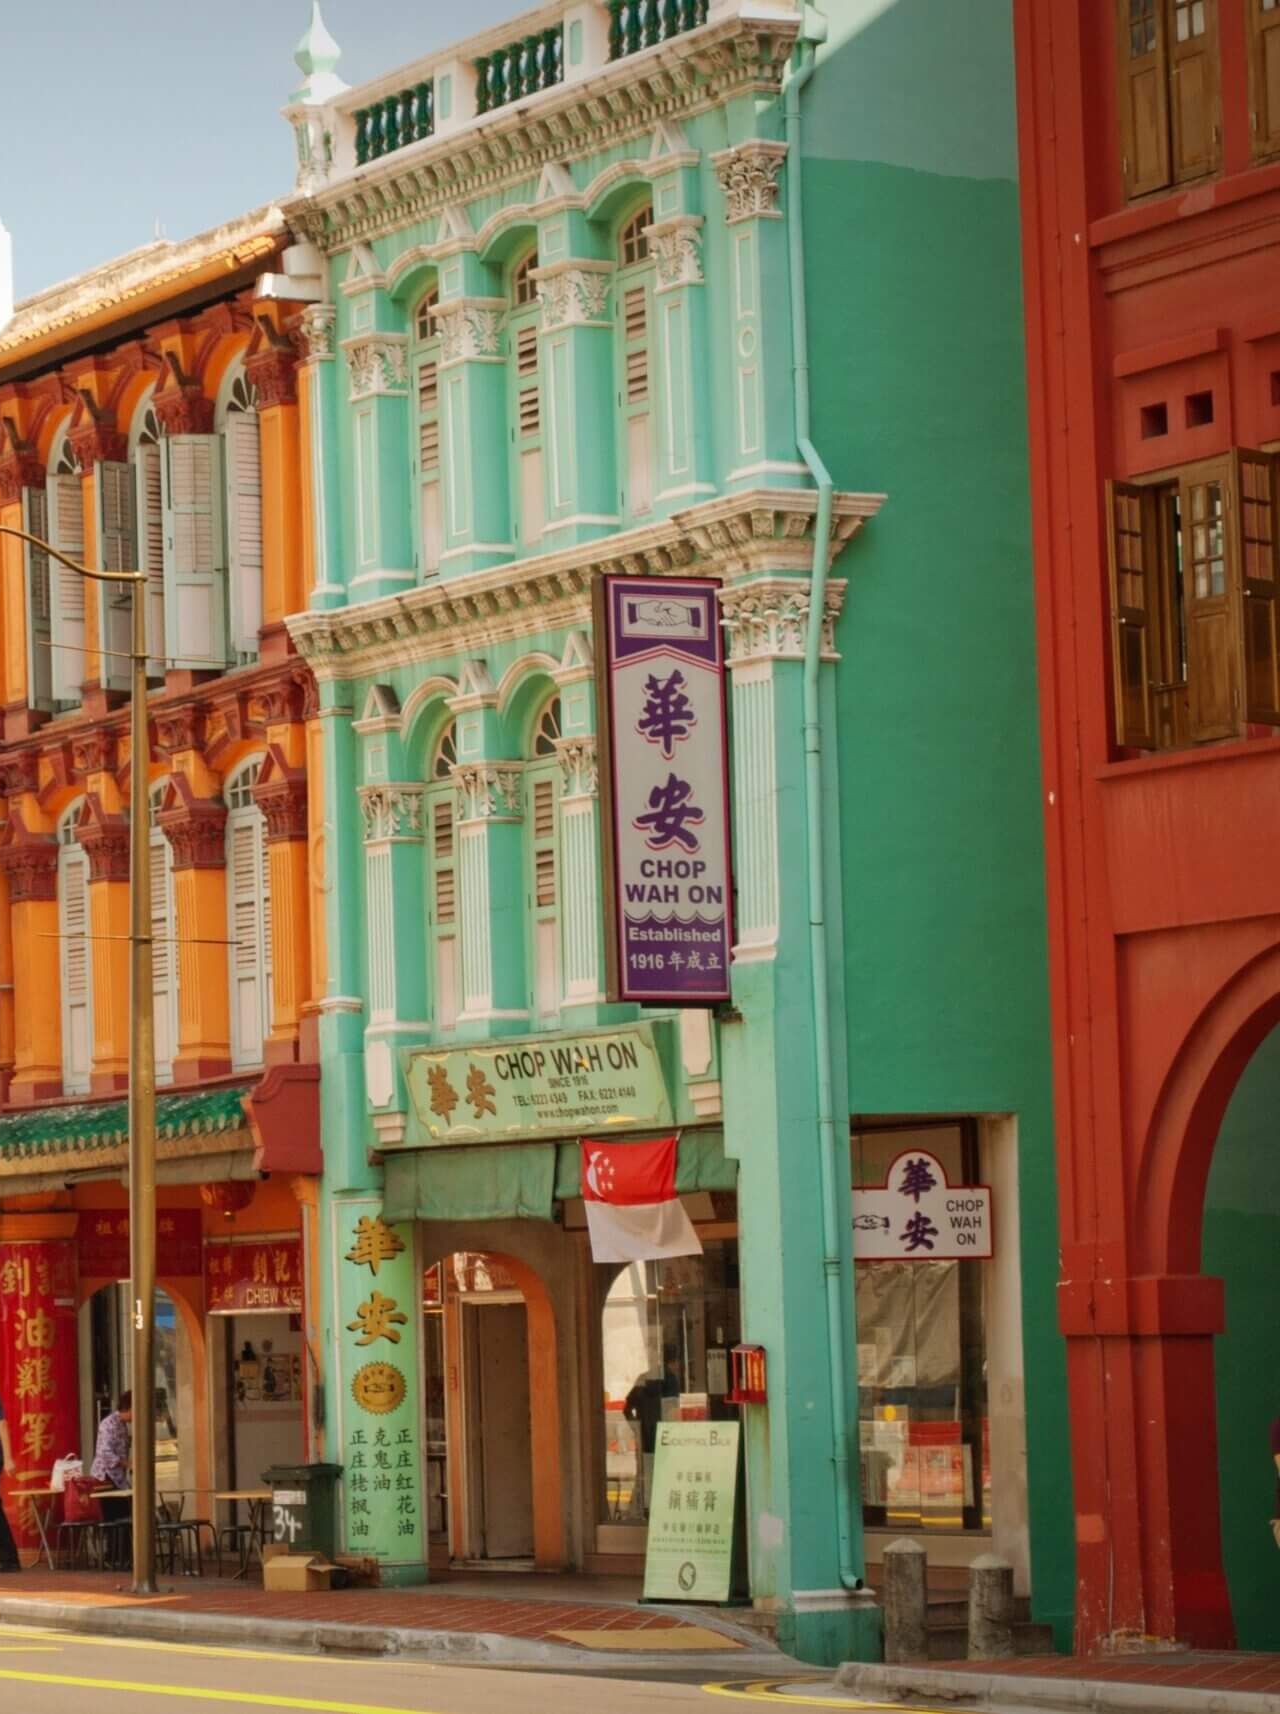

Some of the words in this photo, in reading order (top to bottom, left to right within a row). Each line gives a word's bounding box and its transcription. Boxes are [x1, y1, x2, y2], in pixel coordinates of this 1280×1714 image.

[634, 669, 705, 852] 華安
[640, 859, 706, 879] CHOP
[625, 884, 679, 903] WAH
[688, 885, 722, 904] ON
[628, 927, 721, 942] Established
[630, 953, 664, 970] 1916
[667, 950, 723, 971] 年成立
[494, 1050, 545, 1081] CHOP
[550, 1046, 603, 1076] WAH
[607, 1041, 639, 1072] ON
[898, 1158, 939, 1252] 華安
[946, 1200, 984, 1212] CHOP
[950, 1216, 982, 1229] WAH
[957, 1233, 977, 1245] ON
[344, 1215, 408, 1348] 華安
[373, 1427, 392, 1492] 克鬼油
